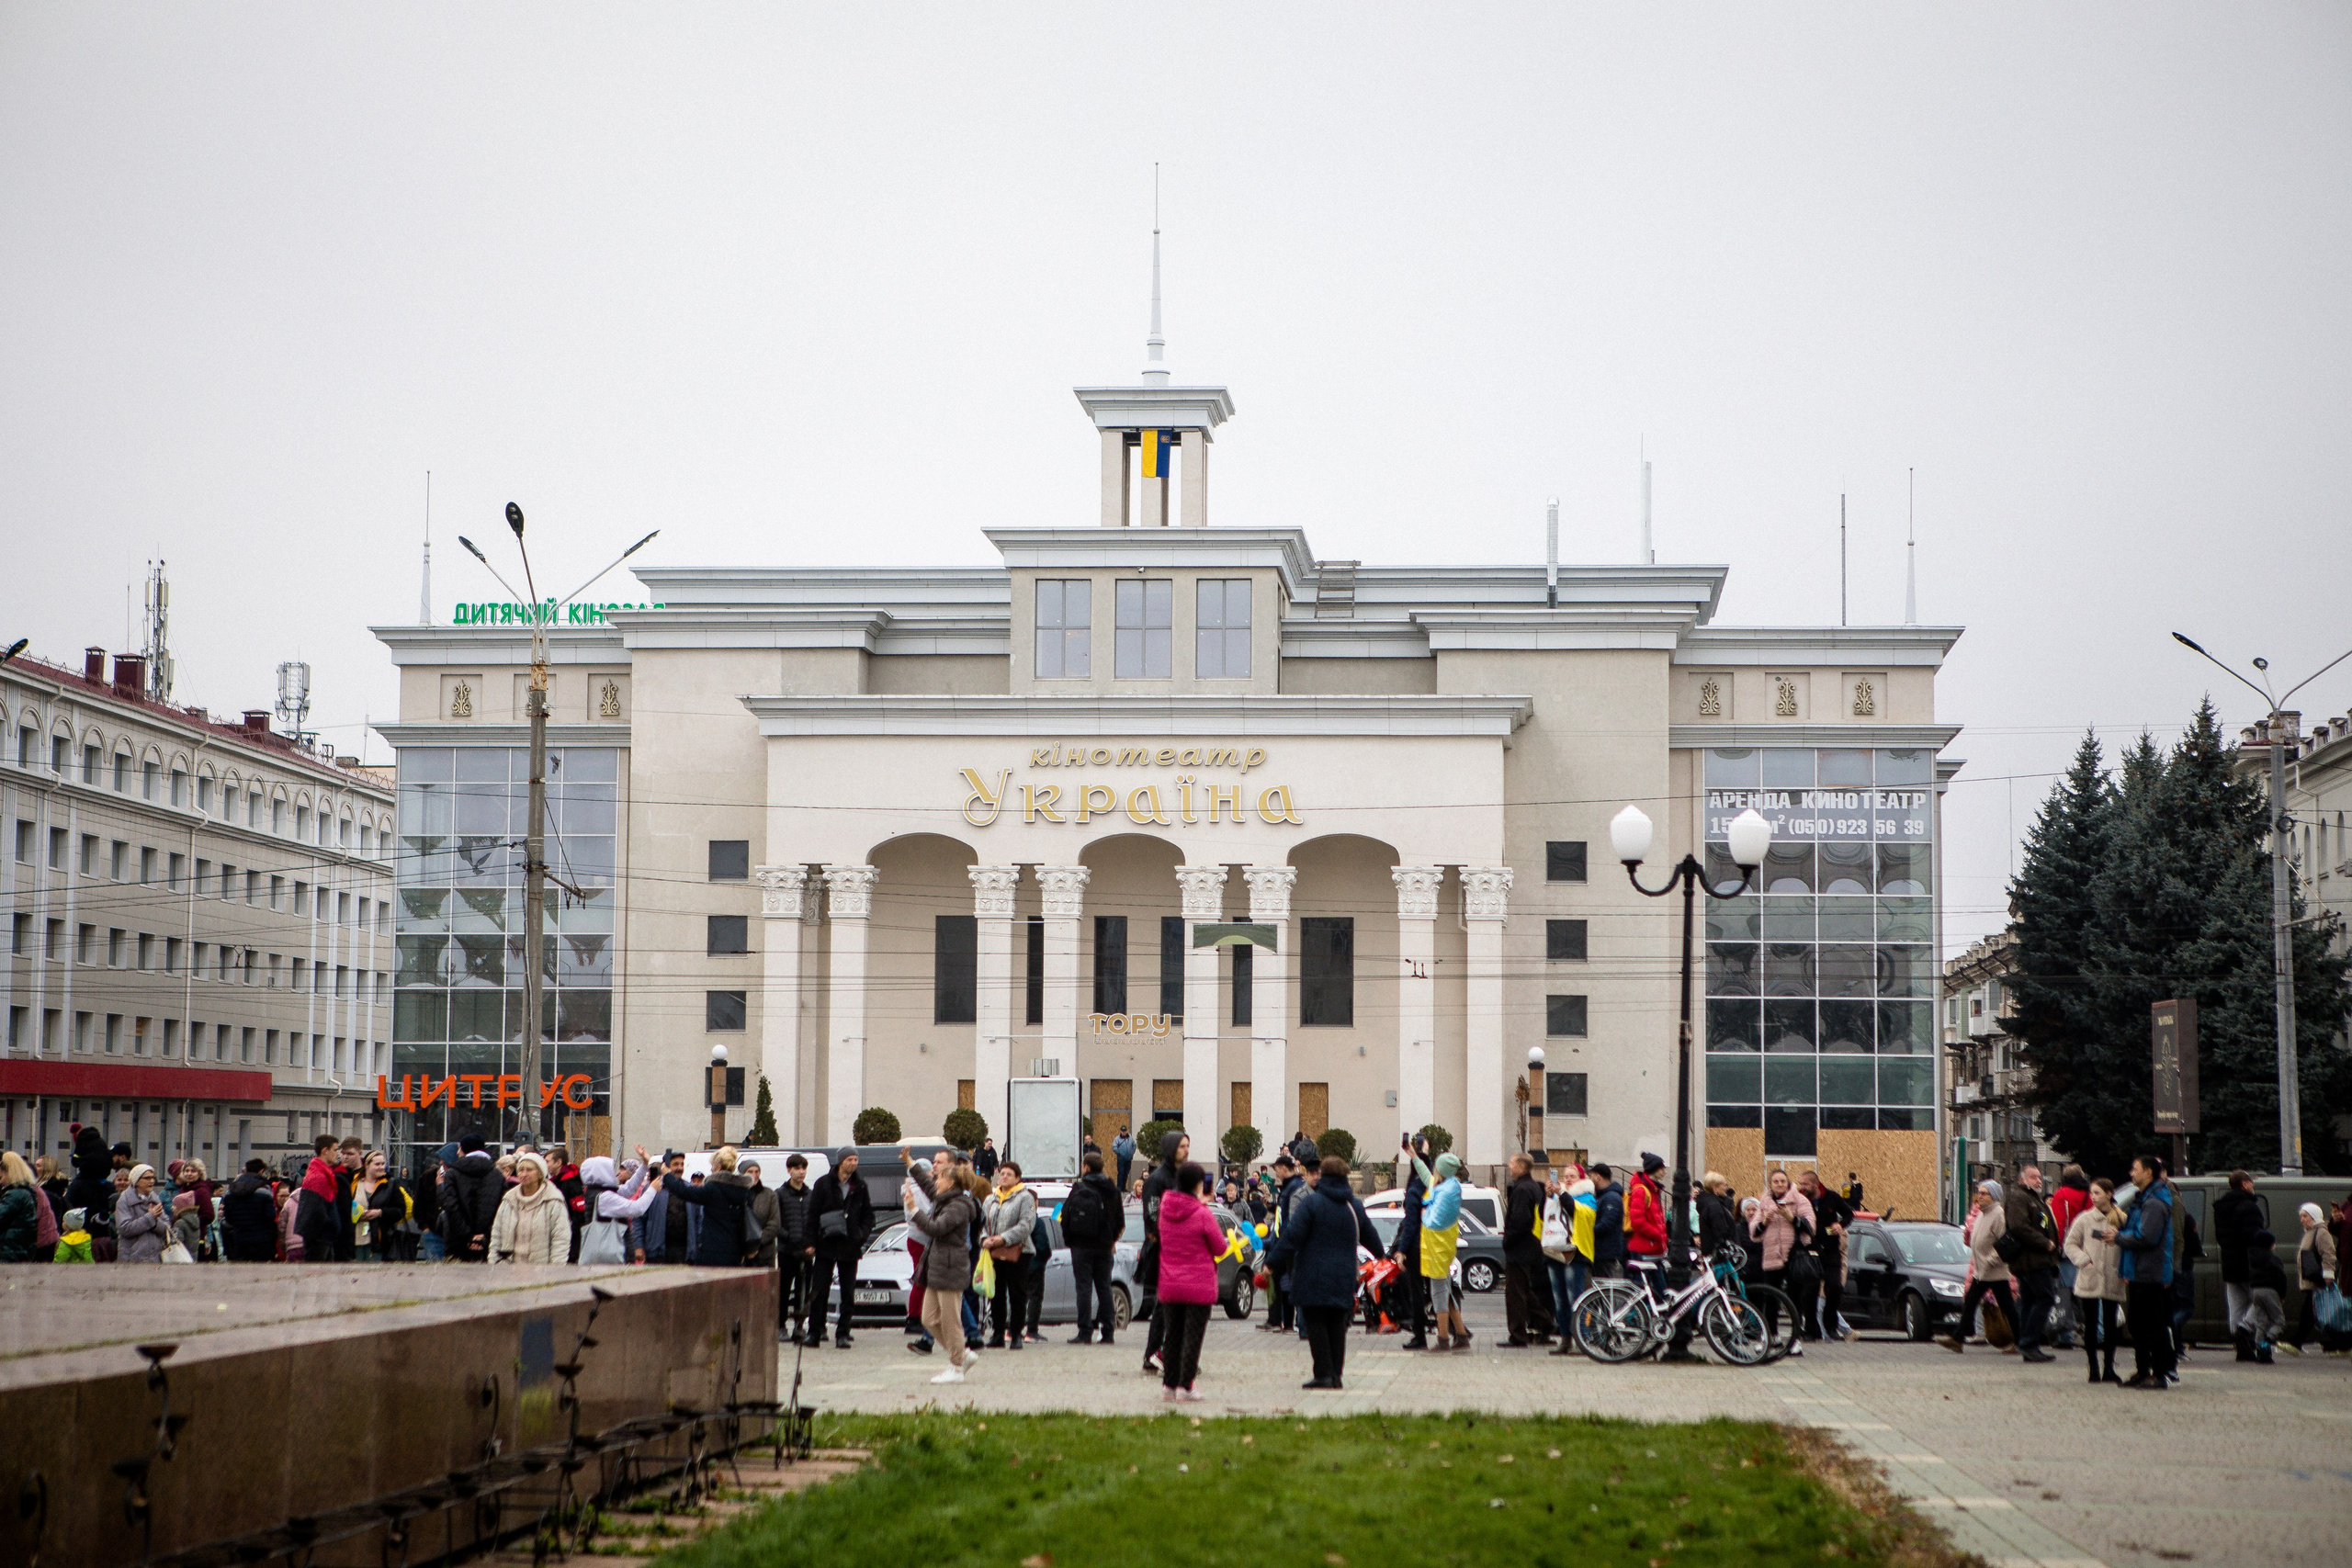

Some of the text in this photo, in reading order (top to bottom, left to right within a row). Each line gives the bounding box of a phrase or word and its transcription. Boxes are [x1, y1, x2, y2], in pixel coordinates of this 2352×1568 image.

[453, 597, 560, 626] ДИТЯЧИЙ
[1028, 740, 1268, 773] кінотеатр
[959, 767, 1304, 826] Україна
[1709, 791, 1792, 810] АРЕНДА
[1837, 820, 1868, 835] 923
[1875, 820, 1896, 835] 56
[1904, 820, 1925, 835] 39
